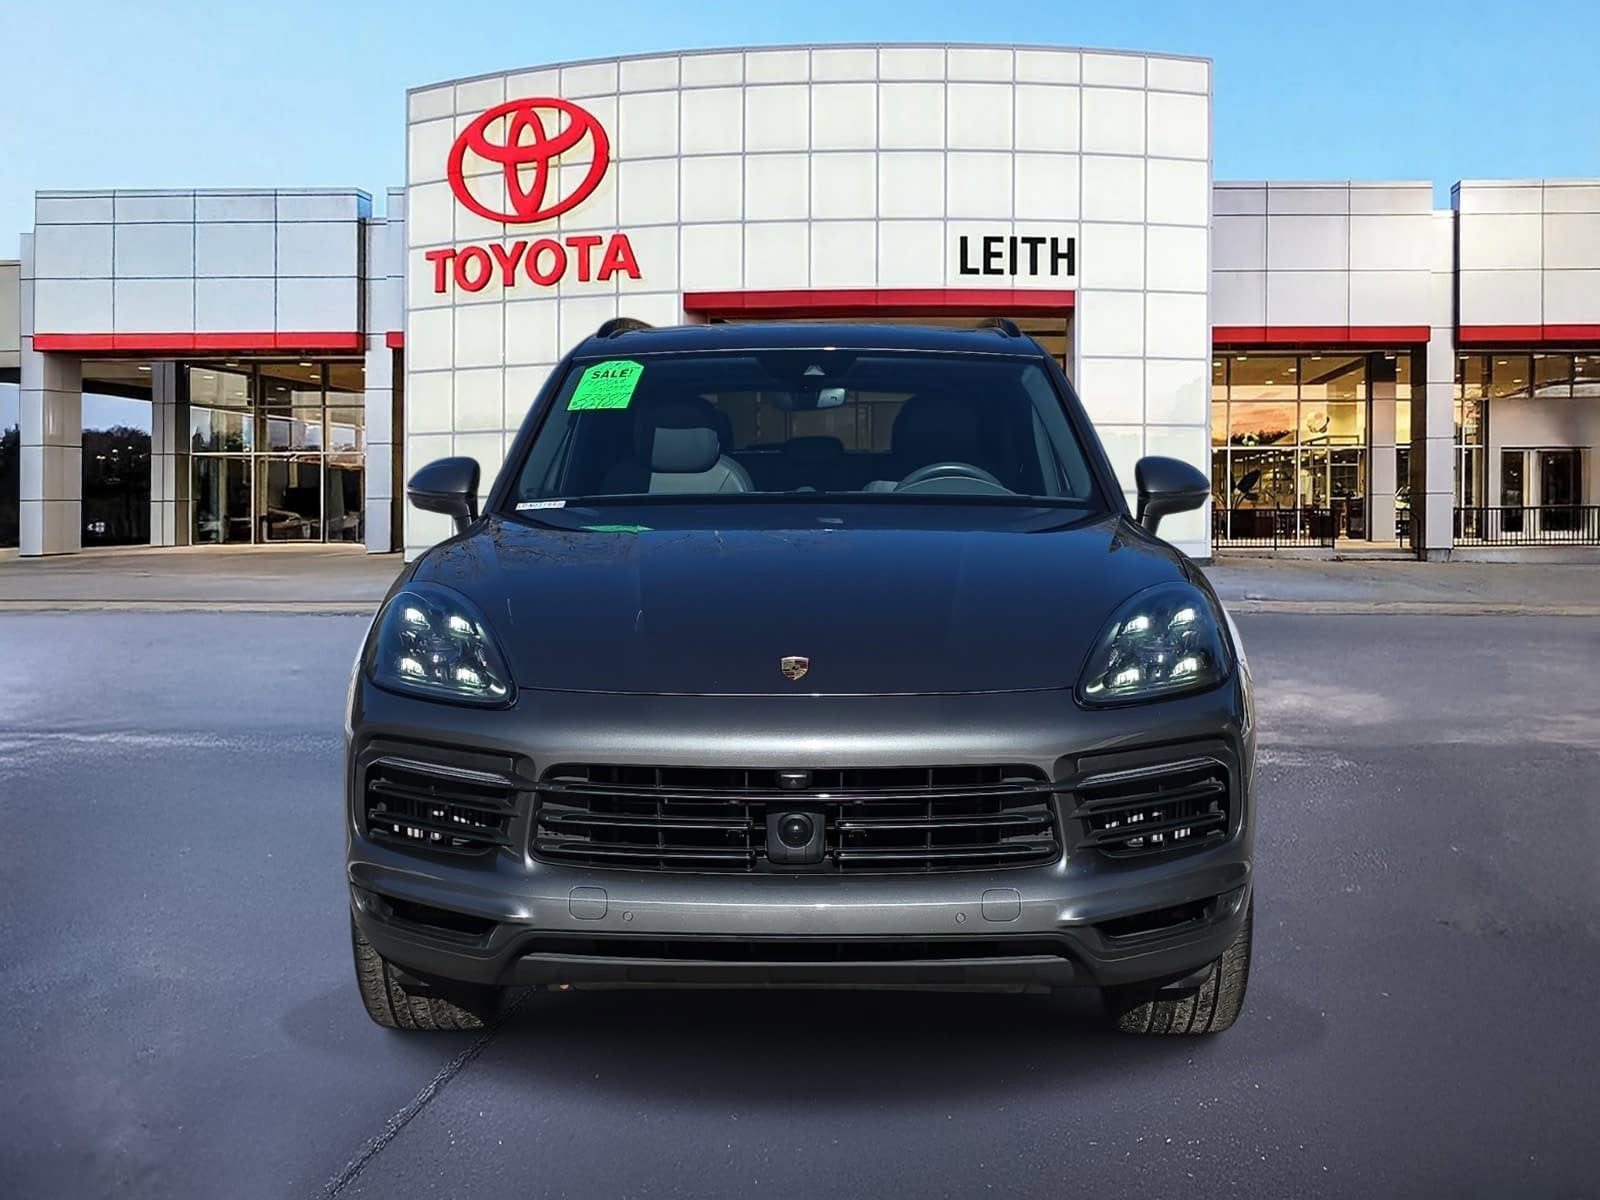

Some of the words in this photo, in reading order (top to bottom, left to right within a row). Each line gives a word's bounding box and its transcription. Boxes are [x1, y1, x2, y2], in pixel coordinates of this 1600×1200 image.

[425, 233, 641, 293] TOYOTA
[960, 236, 1075, 275] LEITH
[592, 369, 634, 379] SALE!
